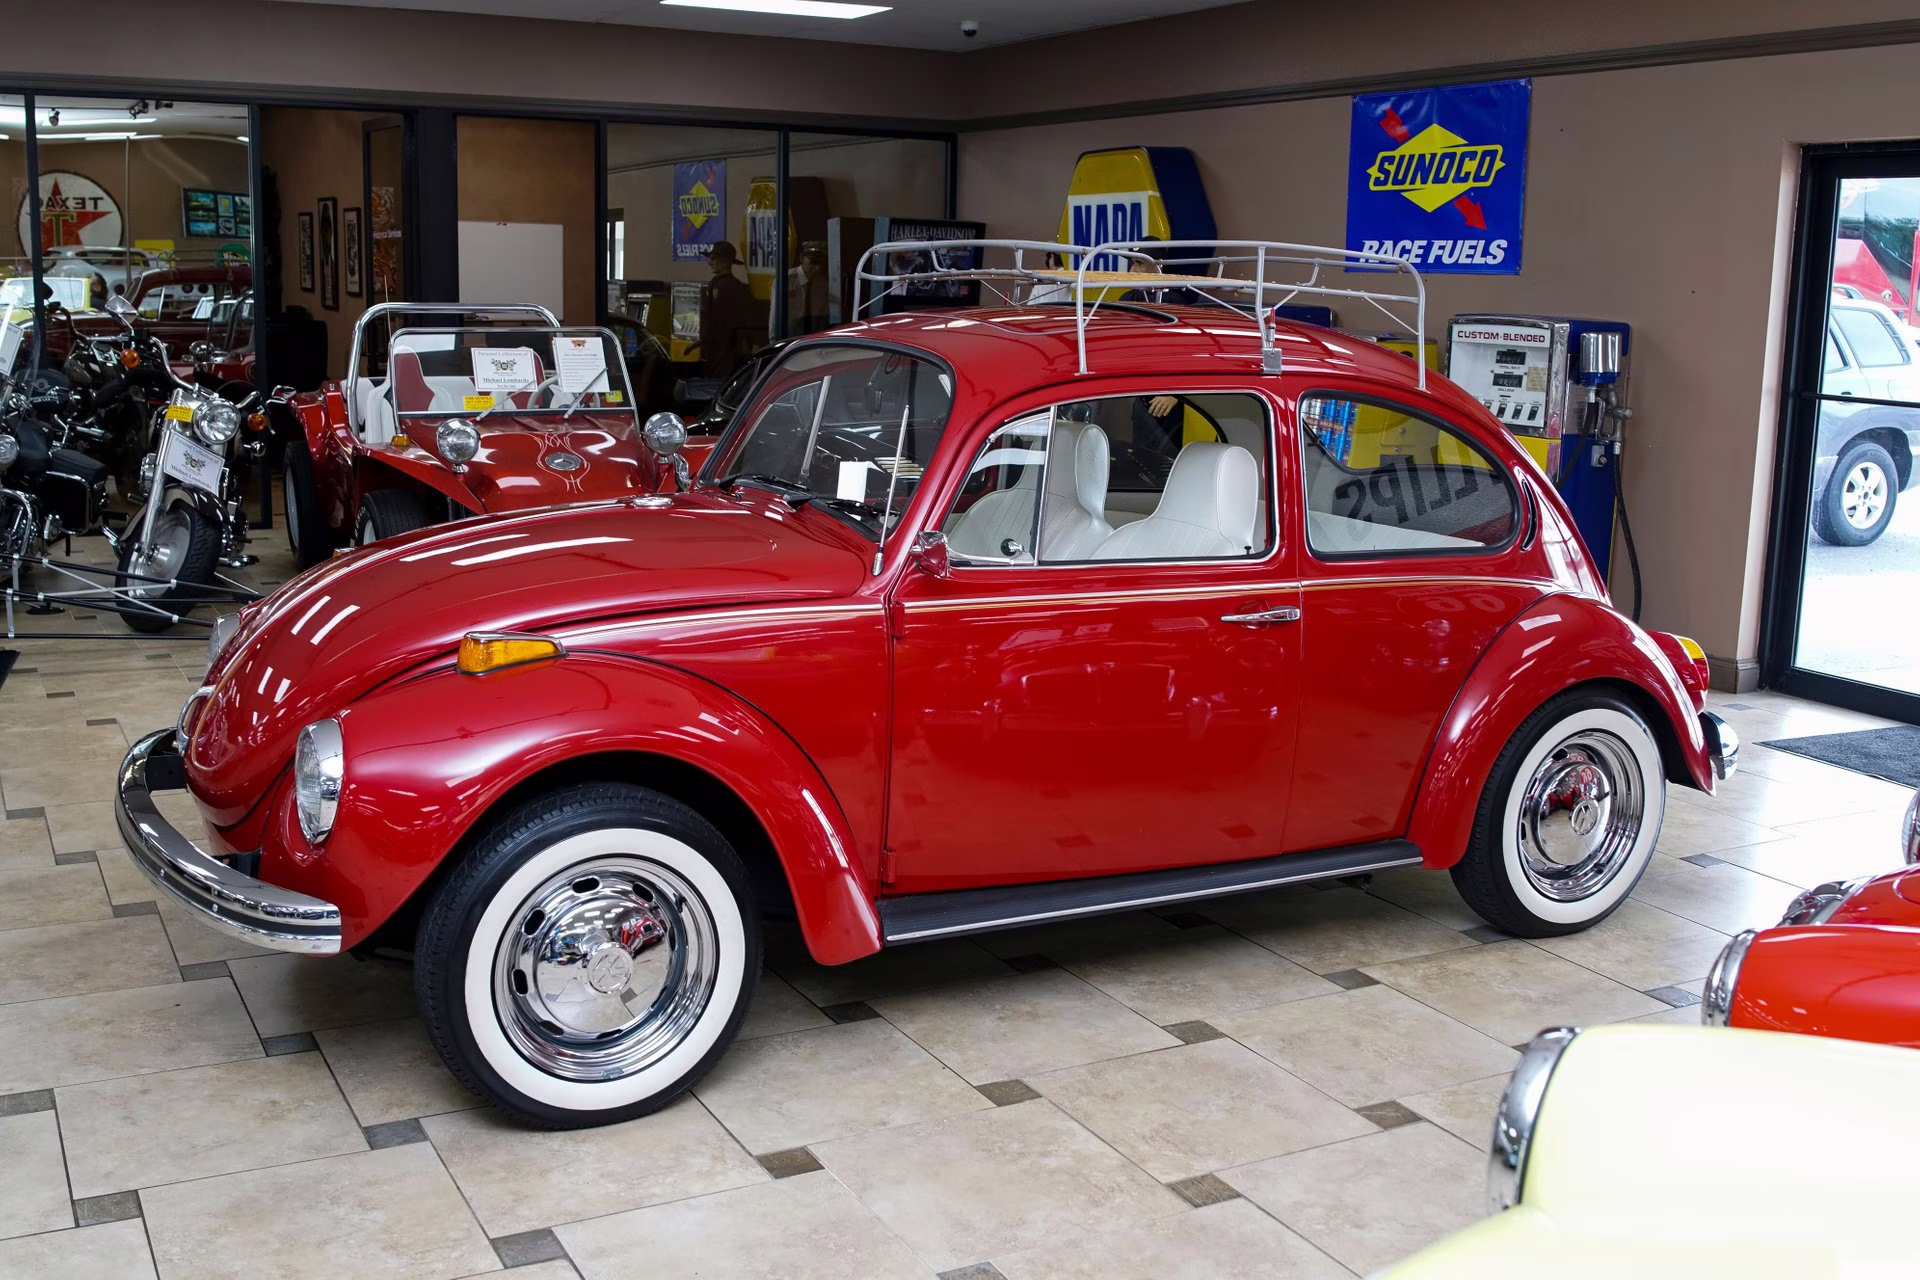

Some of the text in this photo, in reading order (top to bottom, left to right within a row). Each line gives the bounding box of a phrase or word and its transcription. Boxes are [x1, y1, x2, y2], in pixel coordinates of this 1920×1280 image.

[1372, 149, 1500, 187] SUNOCO
[891, 224, 977, 241] HARLEY-DAVIDSON
[1073, 203, 1143, 272] NAPA
[1360, 239, 1508, 264] RACE FUELS
